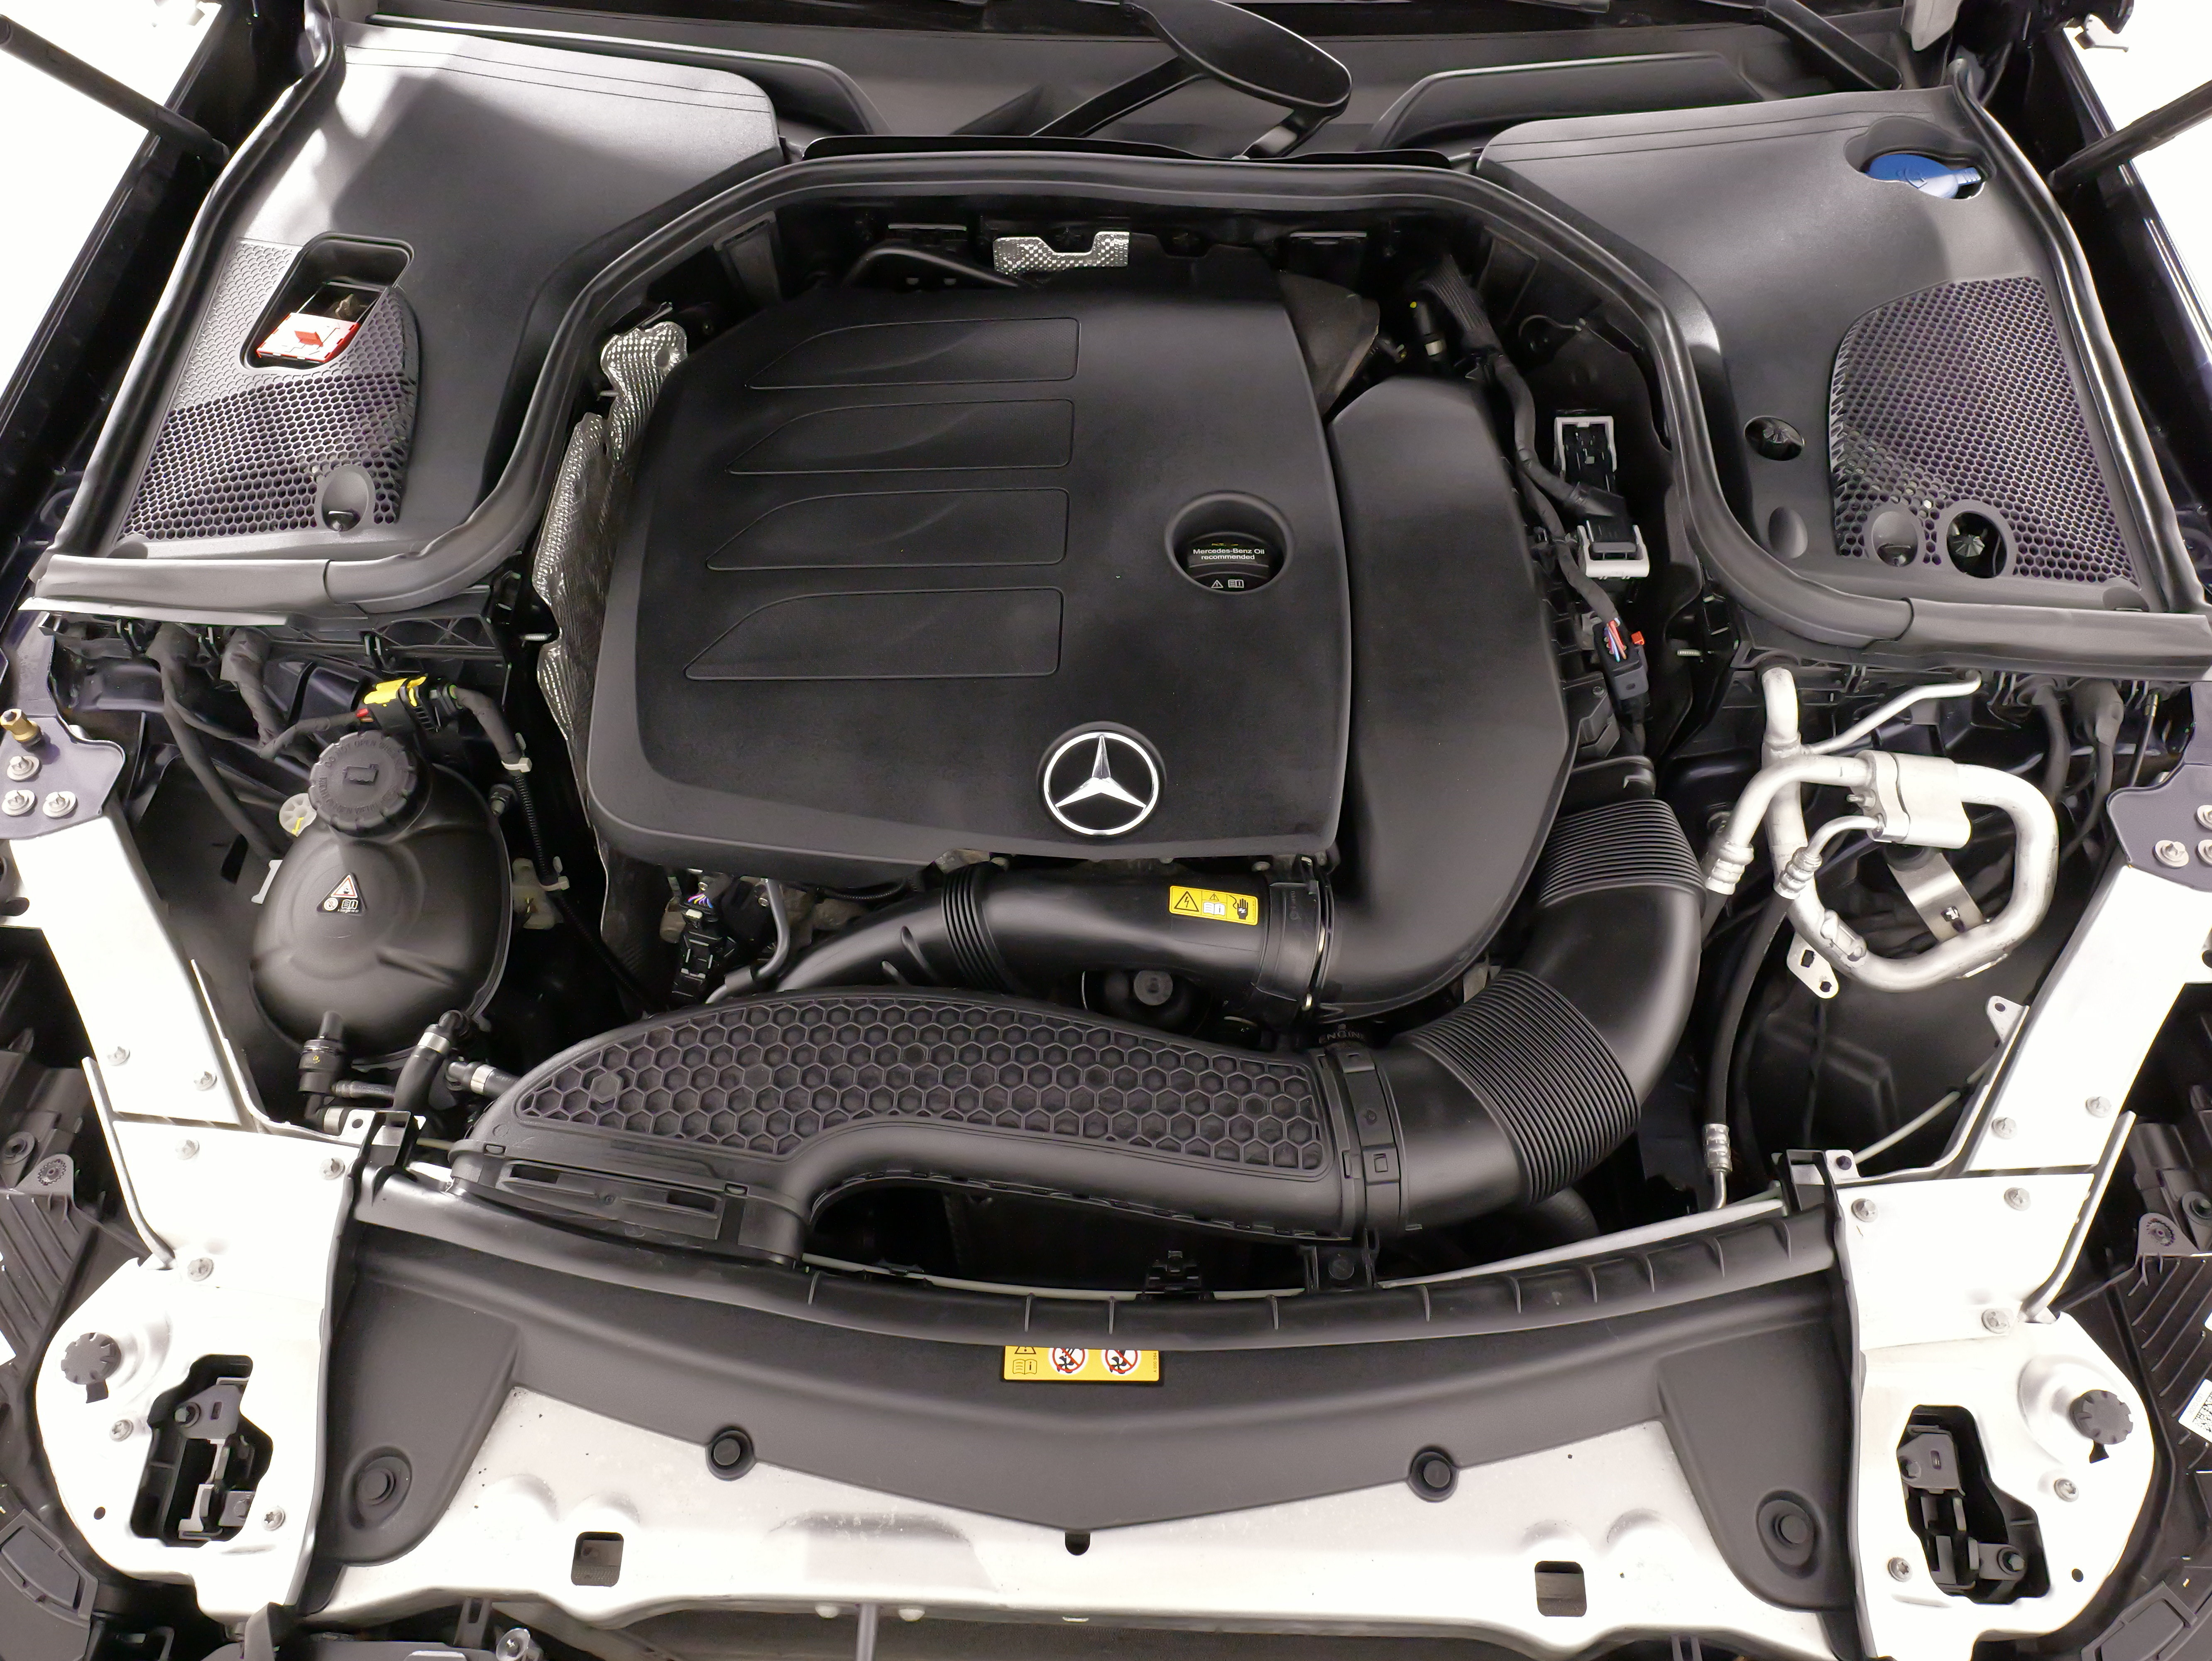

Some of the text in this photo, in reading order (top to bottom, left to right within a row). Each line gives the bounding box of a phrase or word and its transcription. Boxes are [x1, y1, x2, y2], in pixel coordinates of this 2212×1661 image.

[355, 739, 376, 747] OPEN
[2187, 1393, 2205, 1416] LED CODE
